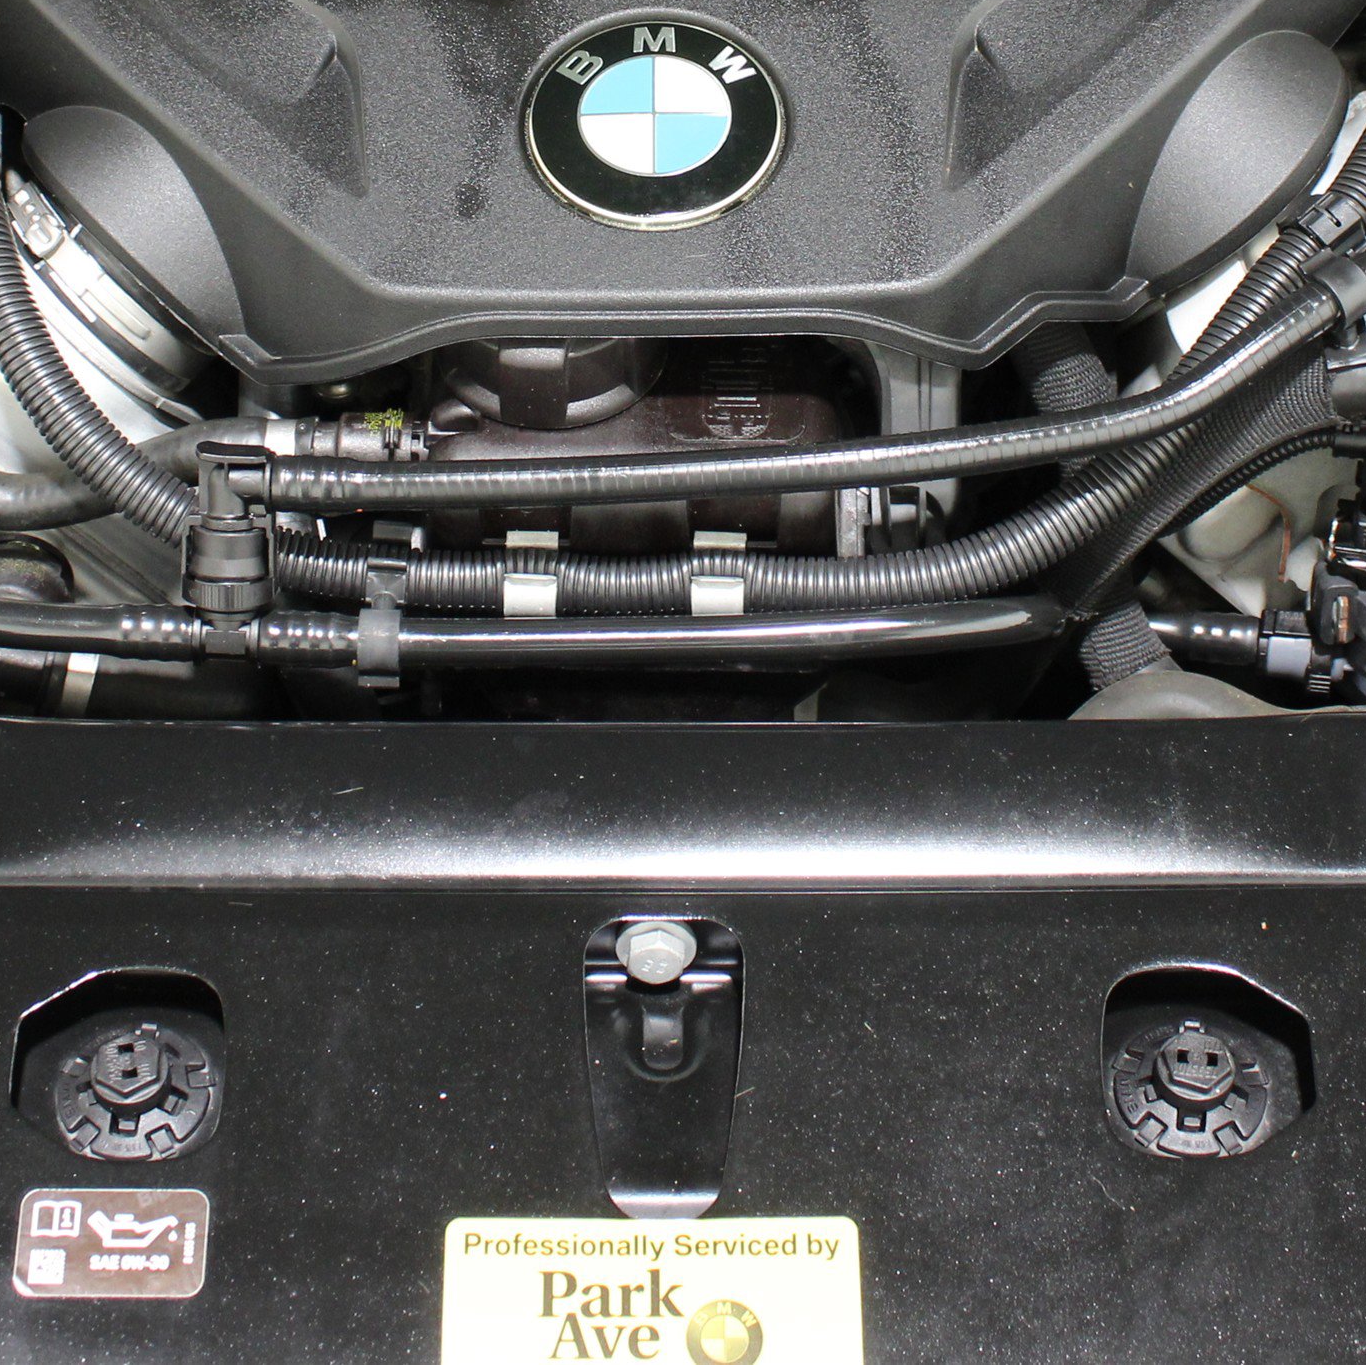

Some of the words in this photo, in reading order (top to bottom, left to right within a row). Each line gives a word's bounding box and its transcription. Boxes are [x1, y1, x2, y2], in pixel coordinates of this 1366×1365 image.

[555, 26, 758, 85] BMW
[463, 1233, 665, 1262] Professionally
[674, 1233, 798, 1257] Serviced
[807, 1233, 840, 1261] by
[538, 1268, 685, 1318] Park
[693, 1300, 758, 1329] BMW
[547, 1311, 661, 1360] Ave
